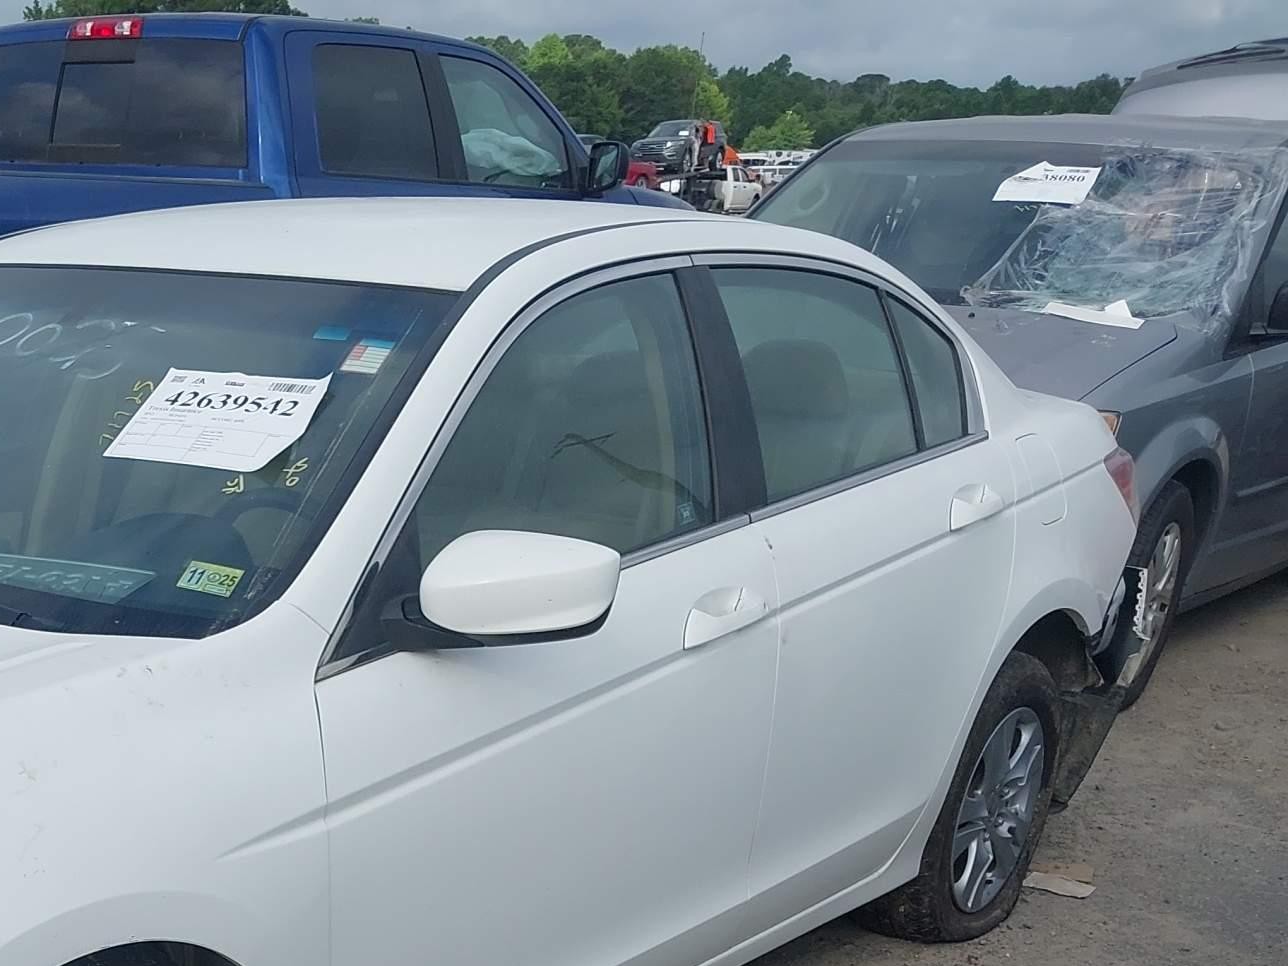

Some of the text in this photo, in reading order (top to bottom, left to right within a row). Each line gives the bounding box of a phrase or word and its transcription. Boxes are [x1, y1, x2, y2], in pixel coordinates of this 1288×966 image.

[164, 390, 300, 417] 42639542
[187, 567, 238, 588] 11 25
